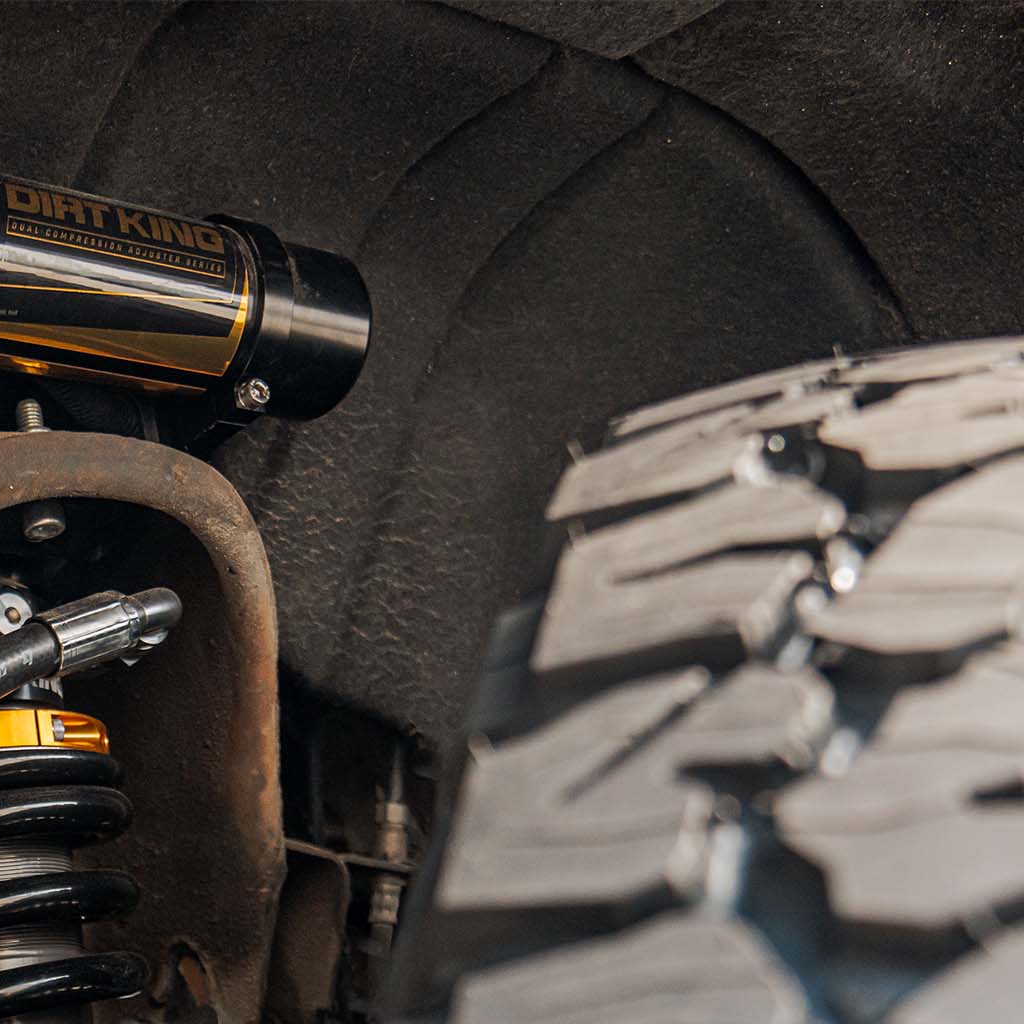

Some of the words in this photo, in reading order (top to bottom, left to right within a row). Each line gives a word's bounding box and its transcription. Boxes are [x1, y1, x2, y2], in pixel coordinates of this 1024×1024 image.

[4, 182, 110, 229] DIRT
[117, 206, 225, 254] KING
[10, 221, 39, 234] DUAL
[45, 227, 122, 252] COMPRESSION
[127, 244, 182, 265] ADJUSTER
[186, 258, 223, 273] SERIES
